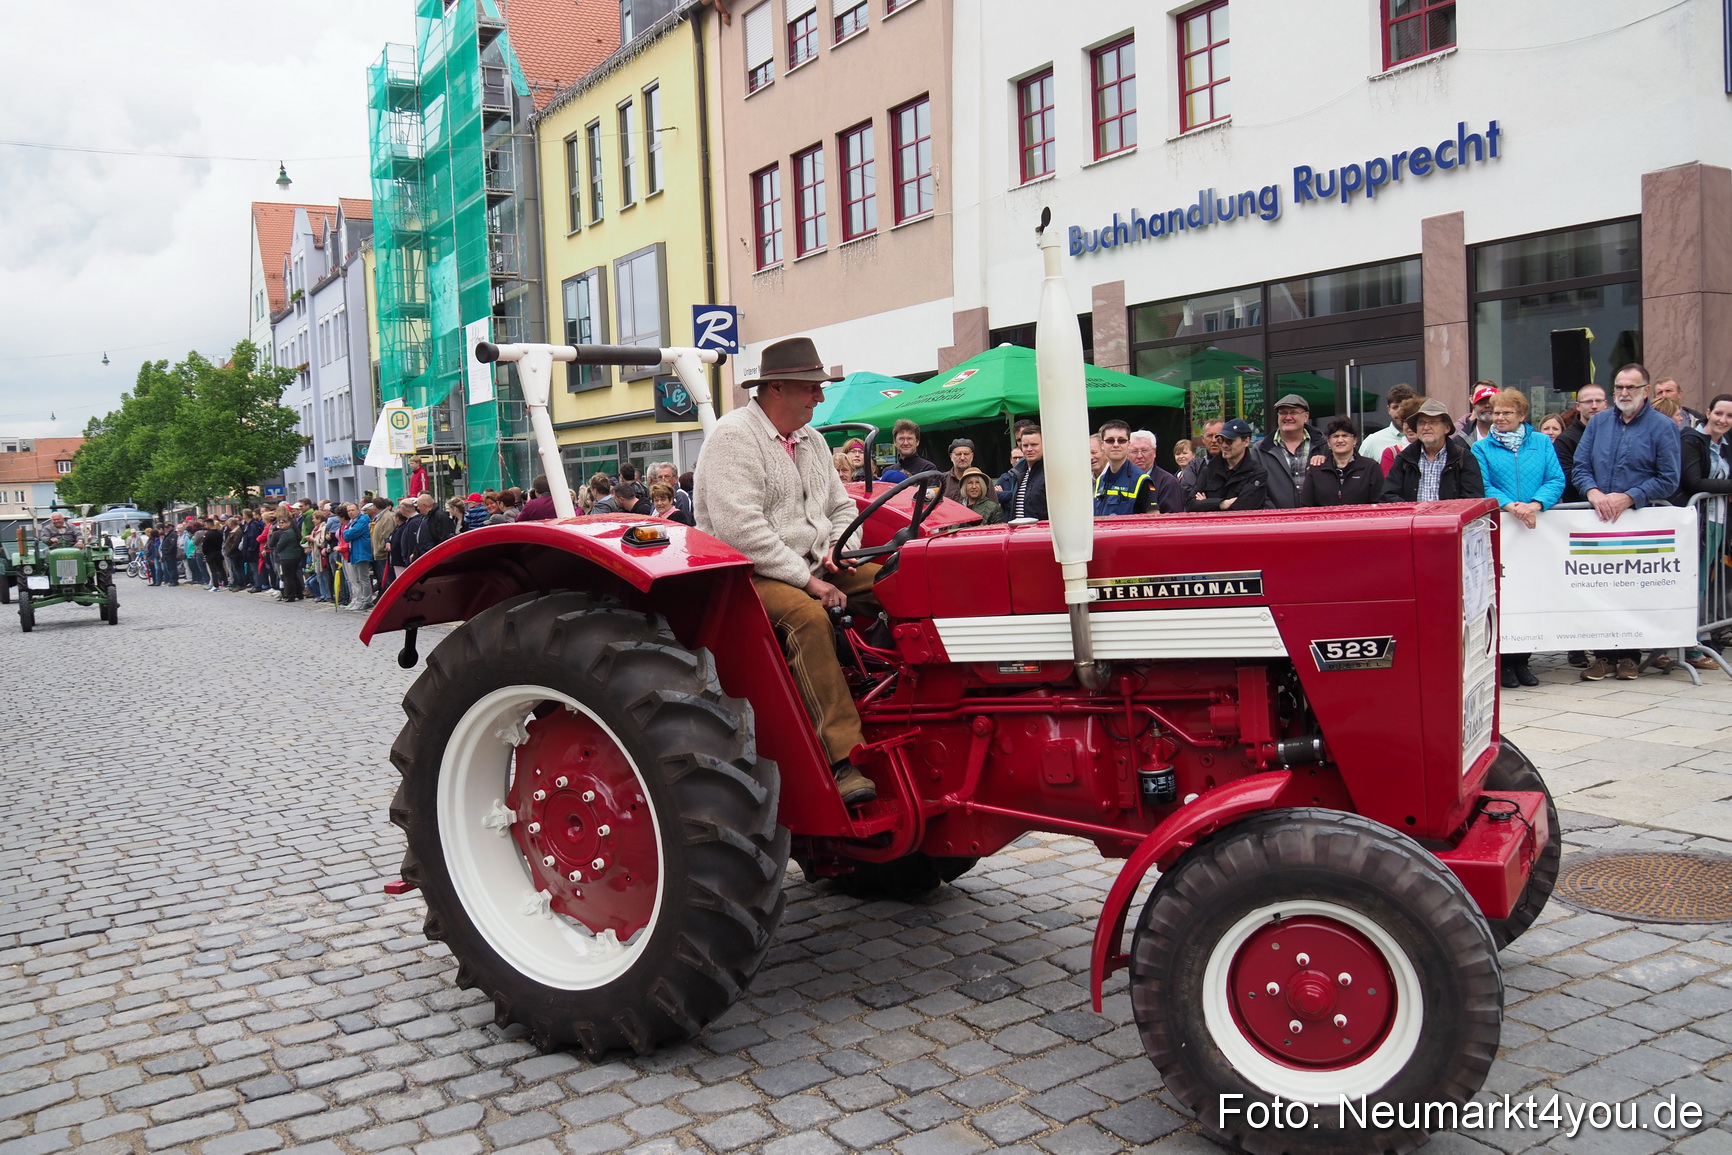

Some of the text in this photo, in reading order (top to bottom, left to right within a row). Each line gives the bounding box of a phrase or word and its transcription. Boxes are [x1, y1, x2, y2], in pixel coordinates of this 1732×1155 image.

[1068, 120, 1503, 256] Buchhandlung Rupprecht
[1565, 557, 1681, 576] NeuerMarkt
[1096, 581, 1249, 600] TERNATIONAL
[1570, 578, 1676, 588] einkaufen leben genießen
[1556, 631, 1644, 640] www.neuermarkt-nm.de
[1326, 641, 1378, 659] 523
